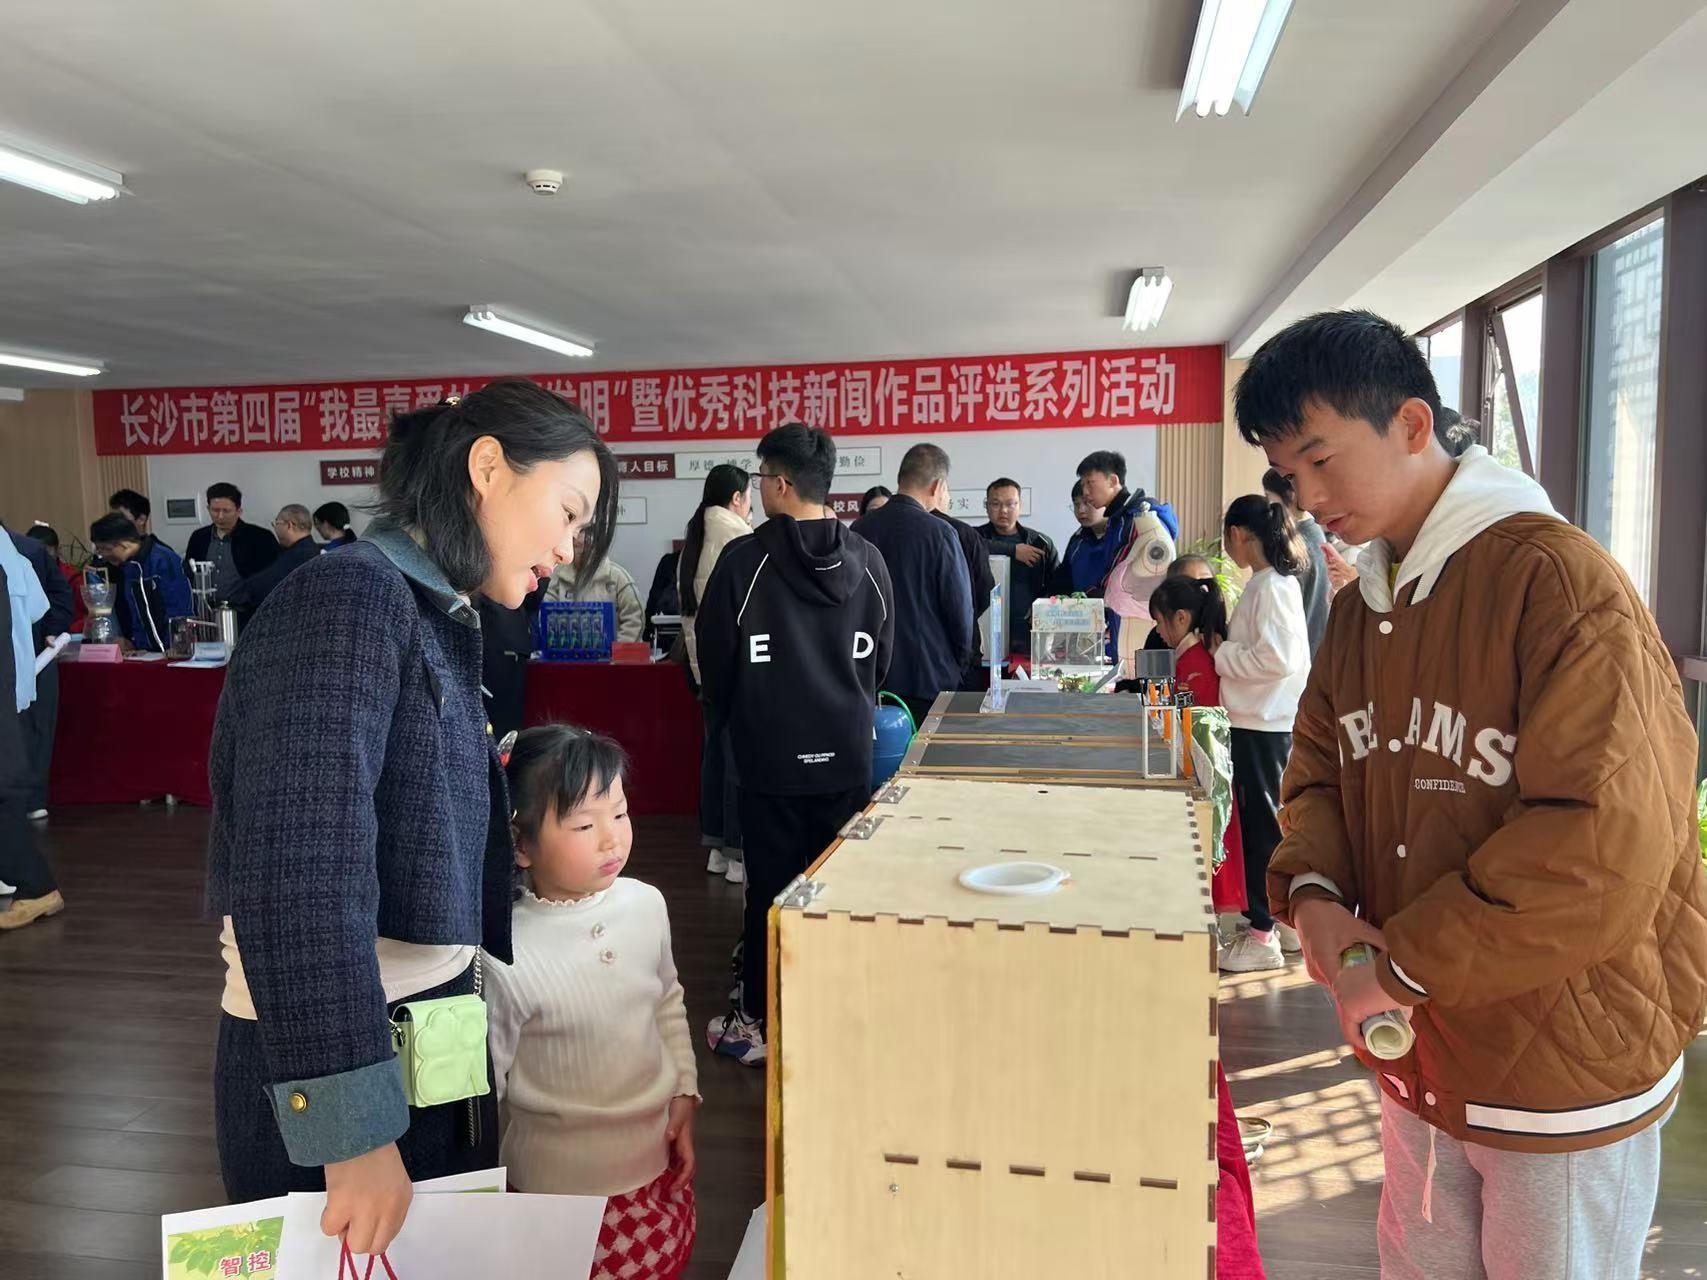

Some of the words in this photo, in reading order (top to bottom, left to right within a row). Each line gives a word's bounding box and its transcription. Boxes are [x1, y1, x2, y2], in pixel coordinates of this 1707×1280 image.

[327, 466, 376, 479] 学校精神
[833, 500, 860, 513] 校风
[750, 634, 771, 663] E
[852, 631, 875, 659] D
